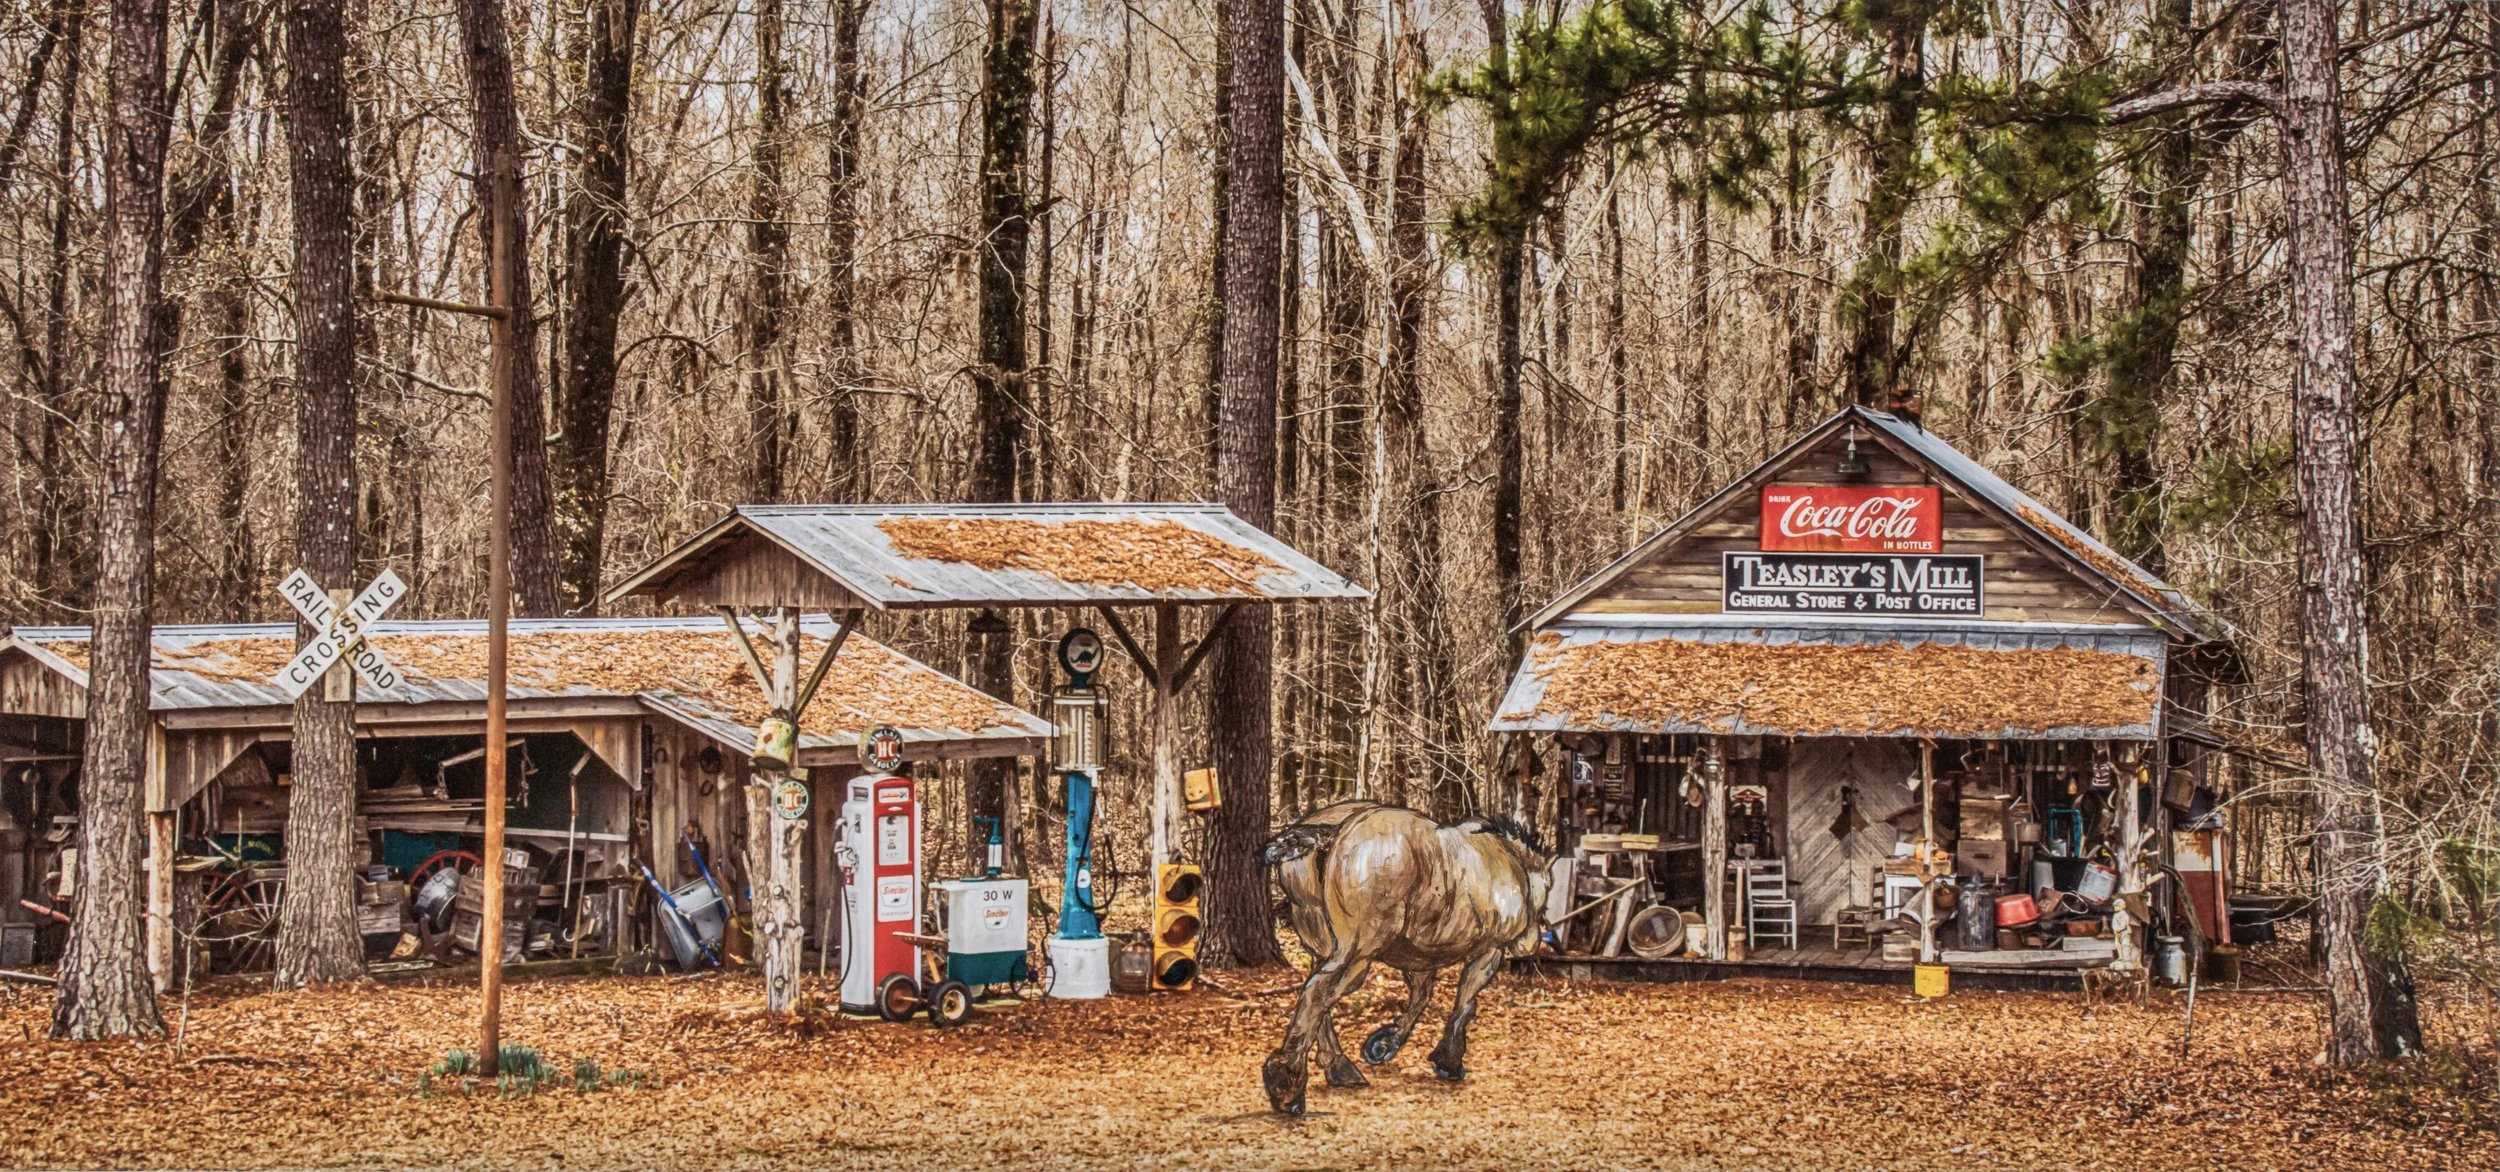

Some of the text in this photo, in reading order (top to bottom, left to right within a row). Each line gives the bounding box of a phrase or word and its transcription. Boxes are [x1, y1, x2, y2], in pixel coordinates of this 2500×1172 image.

[1768, 495, 1791, 503] DRINK
[1780, 496, 1923, 538] Coca-Cola
[1884, 540, 1933, 550] IN BOTTLES
[1733, 556, 1973, 592] TEASLEY'S MILL
[1729, 591, 1976, 611] GENERAL STORE & POST OFFICE
[287, 577, 395, 690] RAIL ROAD
[290, 581, 395, 685] CROSSING
[877, 740, 896, 758] HC
[983, 889, 1013, 901] 30 W
